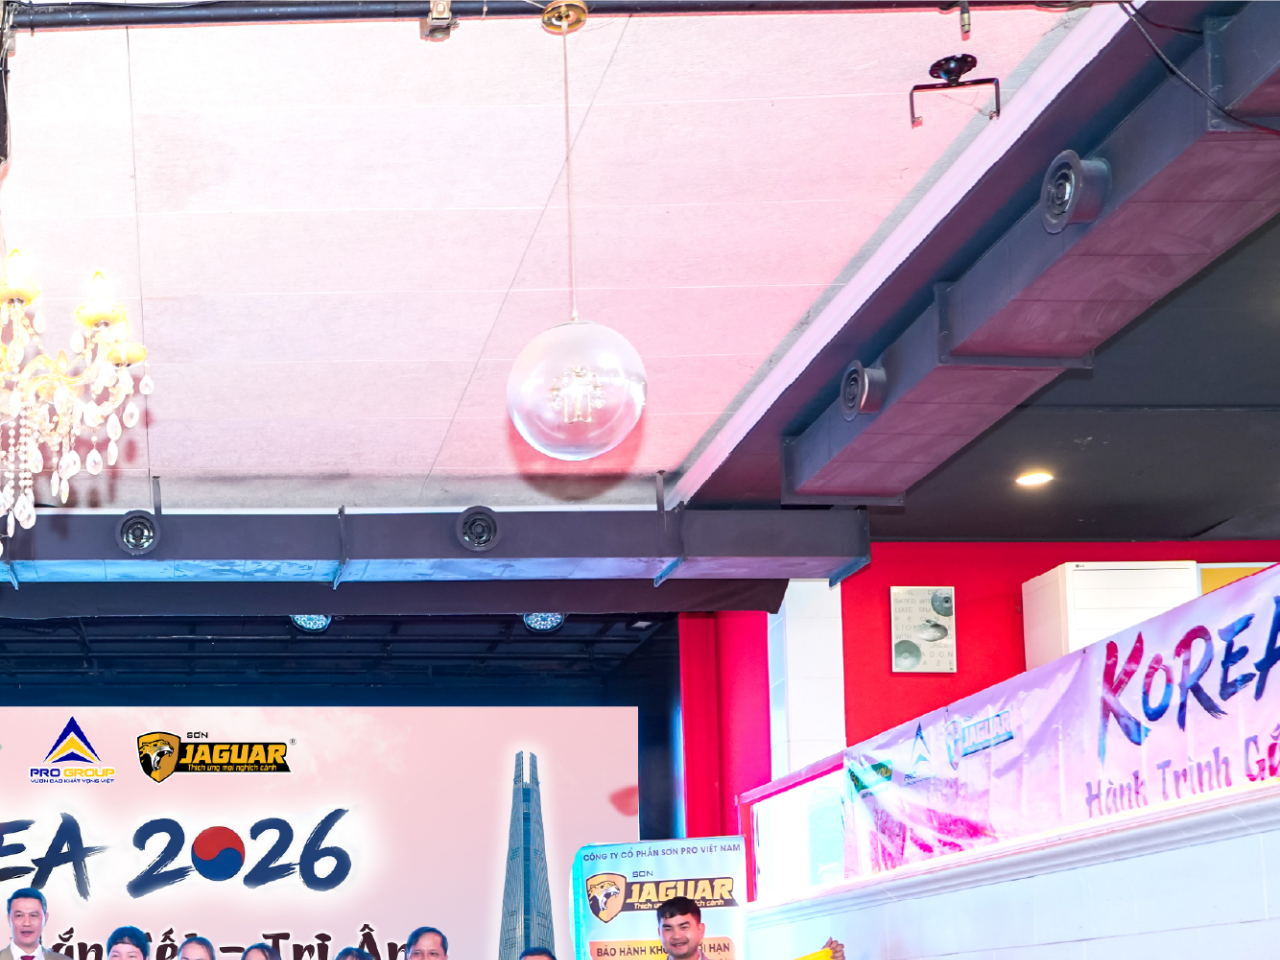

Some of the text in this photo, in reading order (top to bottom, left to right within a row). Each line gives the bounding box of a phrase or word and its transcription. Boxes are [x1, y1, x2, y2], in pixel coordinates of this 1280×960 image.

[179, 744, 287, 764] JAGUAR
[30, 768, 115, 777] PRO GROUP
[1156, 746, 1233, 801] Trình
[125, 808, 351, 899] 2026
[583, 852, 608, 862] CÔNG
[610, 852, 619, 860] TY
[681, 847, 698, 855] PRO
[700, 845, 717, 855] VIỆT
[720, 844, 741, 852] NAM
[625, 878, 733, 904] JAGUAR
[708, 943, 730, 955] HẠN
